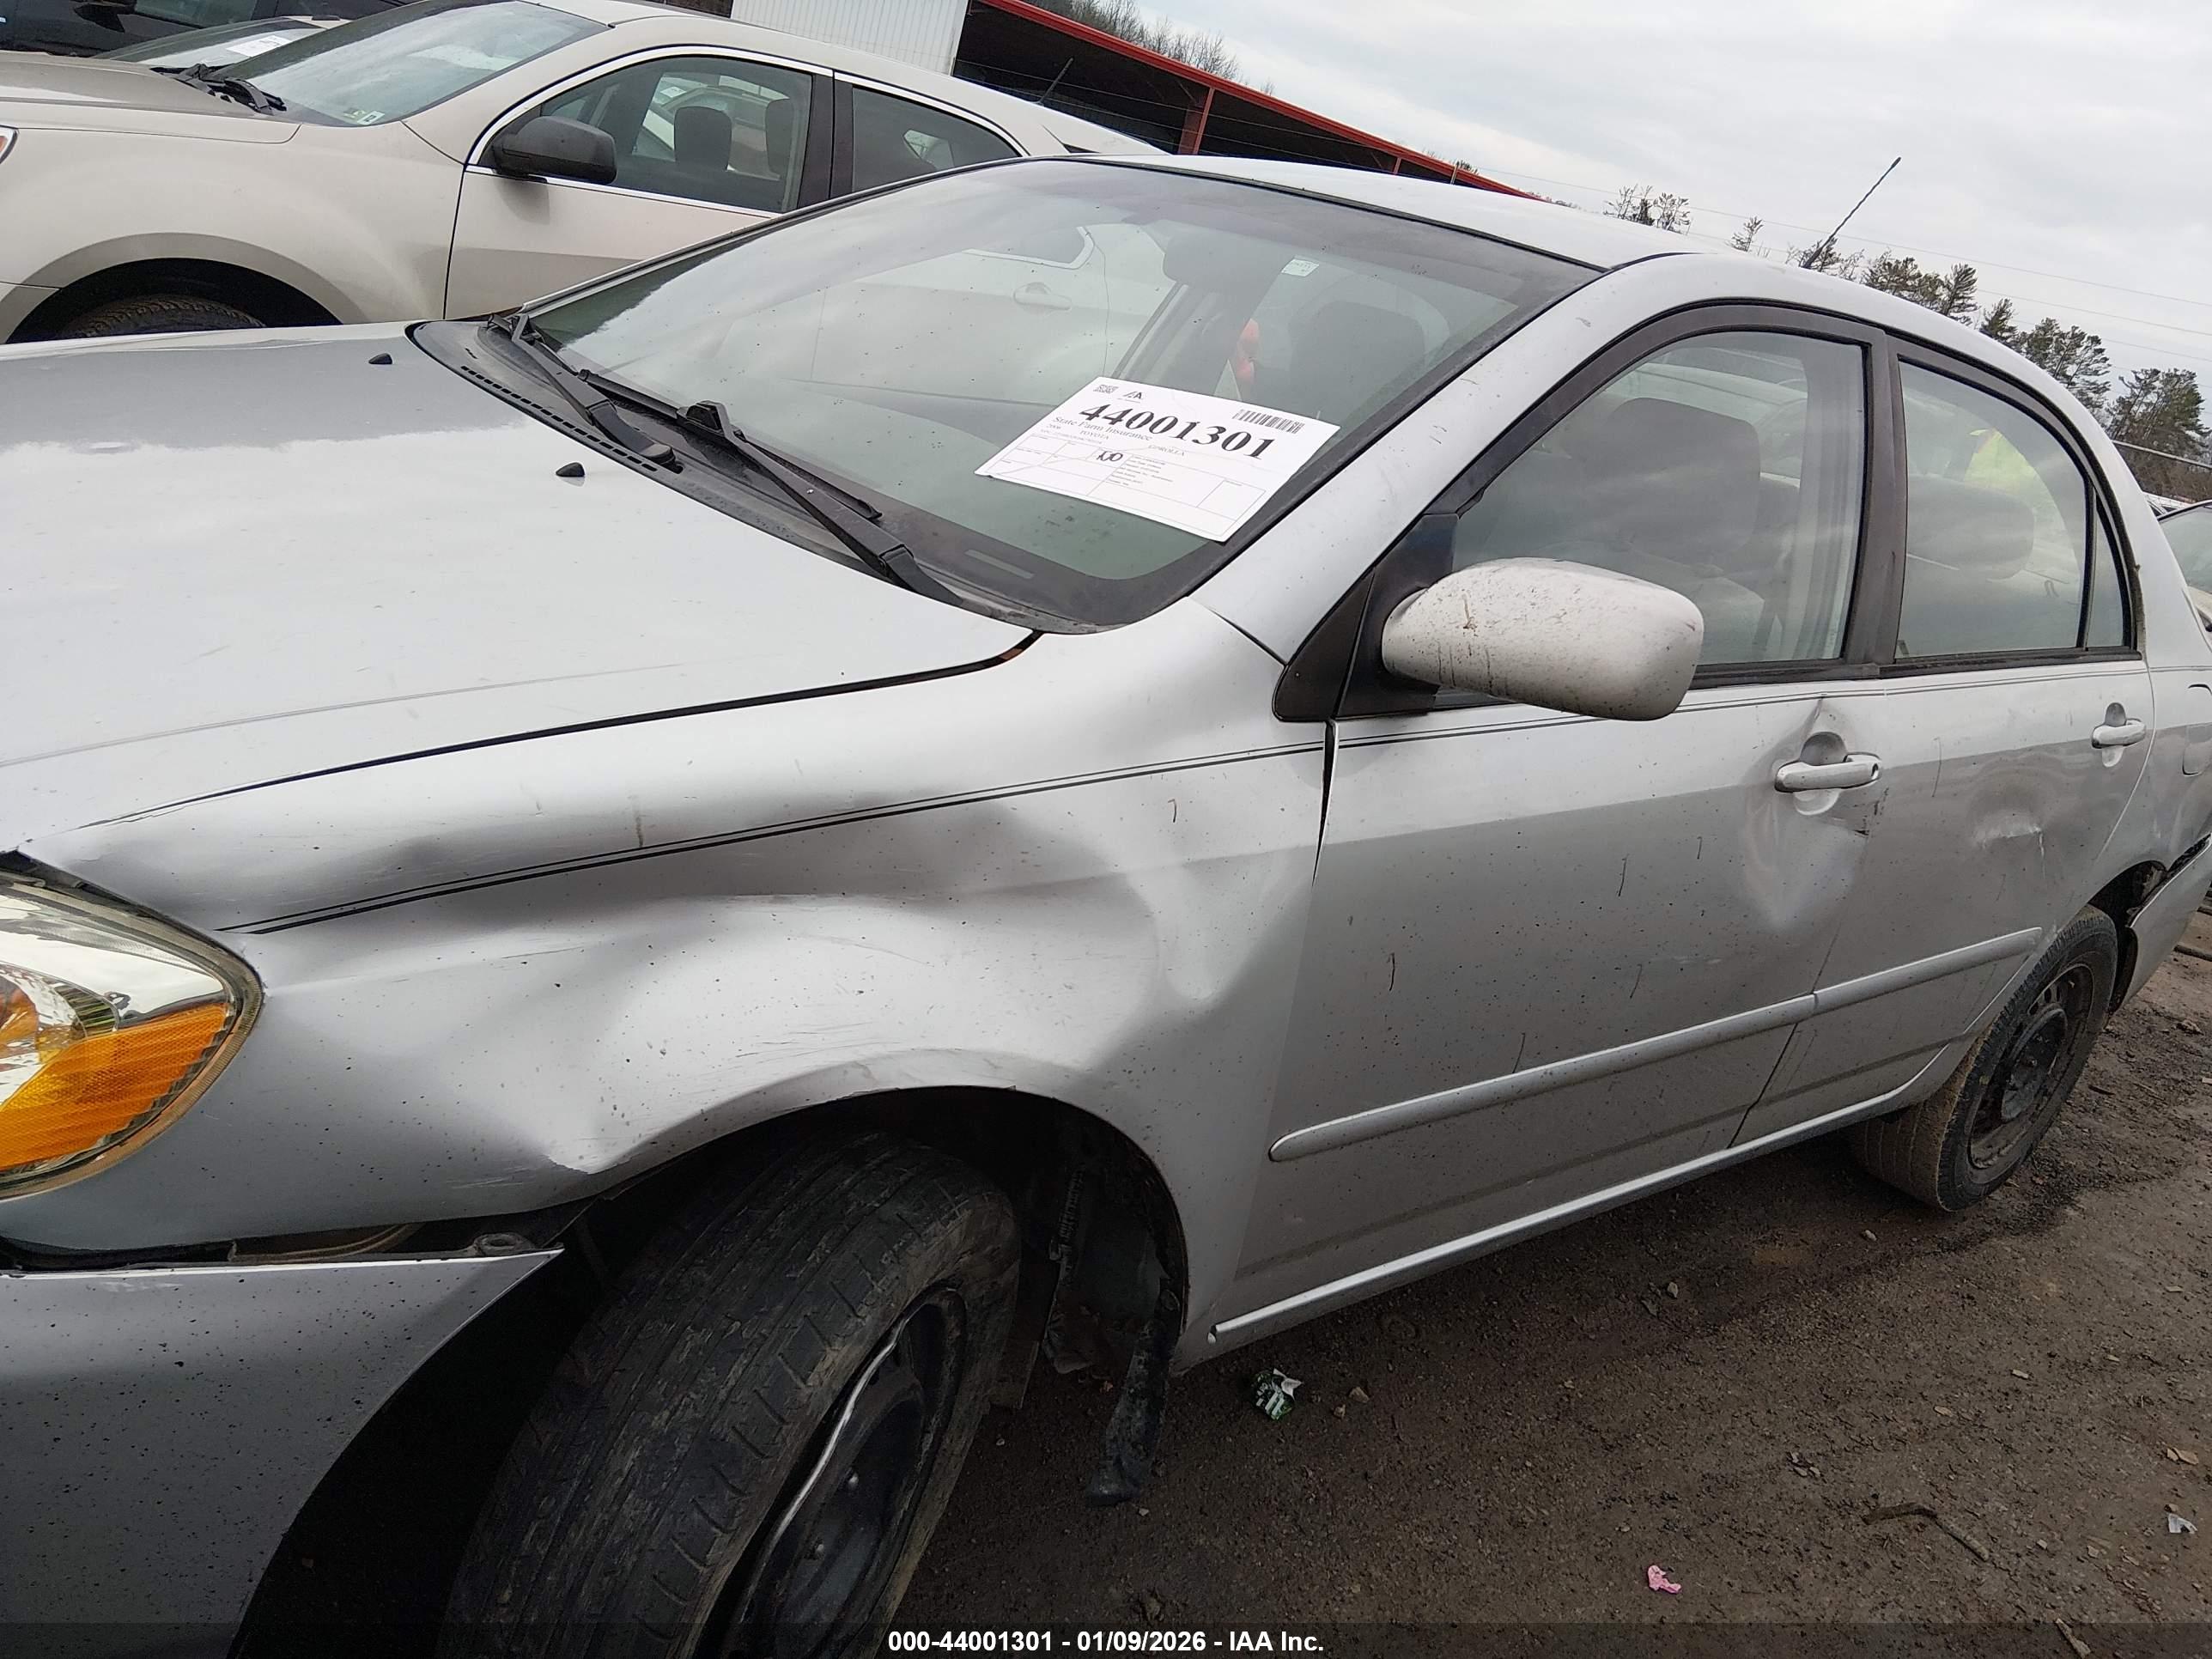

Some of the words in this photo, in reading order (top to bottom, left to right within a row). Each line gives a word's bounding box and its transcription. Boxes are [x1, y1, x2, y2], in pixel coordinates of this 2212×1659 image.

[1053, 416, 1078, 426] State
[1079, 421, 1104, 432] Farm
[1105, 426, 1152, 441] Insurance
[1079, 404, 1275, 460] 44001301
[1079, 430, 1109, 440] TOYOTA
